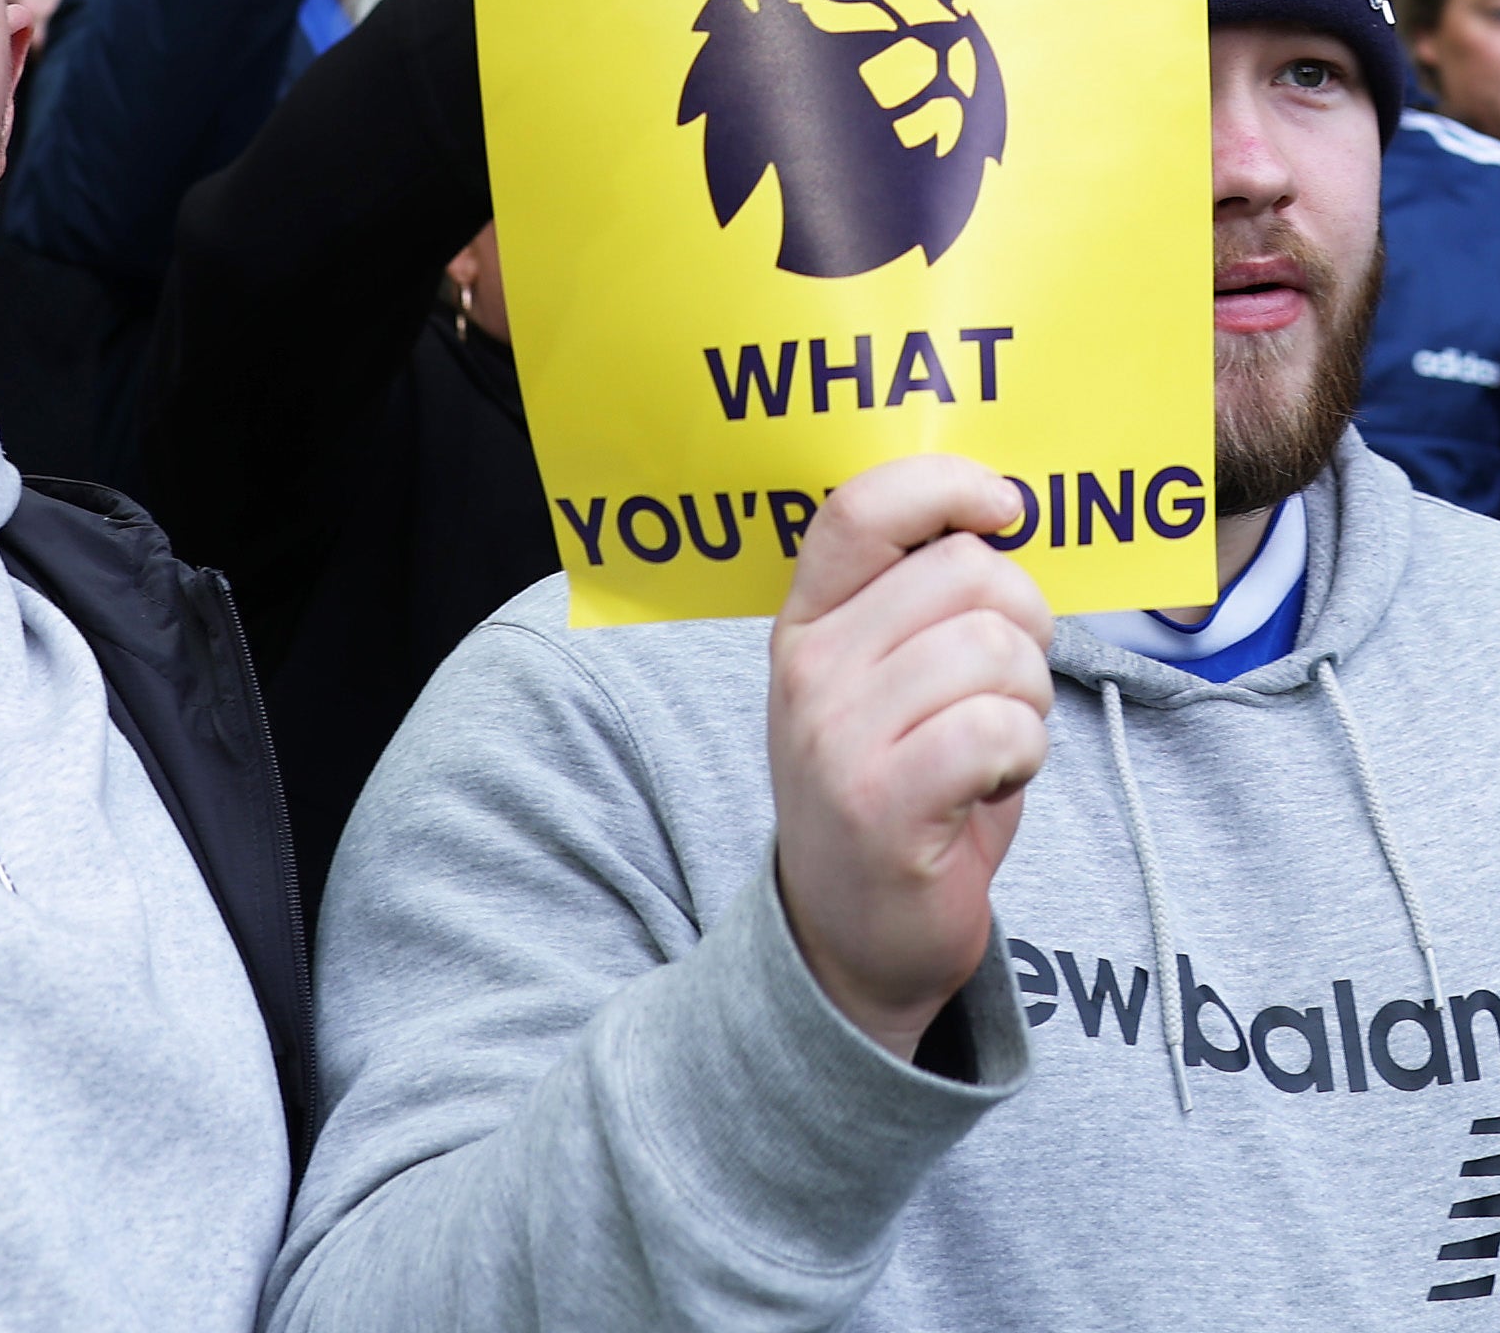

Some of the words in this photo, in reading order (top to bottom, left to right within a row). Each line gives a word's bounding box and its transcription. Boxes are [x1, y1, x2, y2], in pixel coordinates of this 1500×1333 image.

[703, 327, 1013, 420] WHAT
[555, 490, 833, 566] YOU'R
[1005, 937, 1148, 1046] ew
